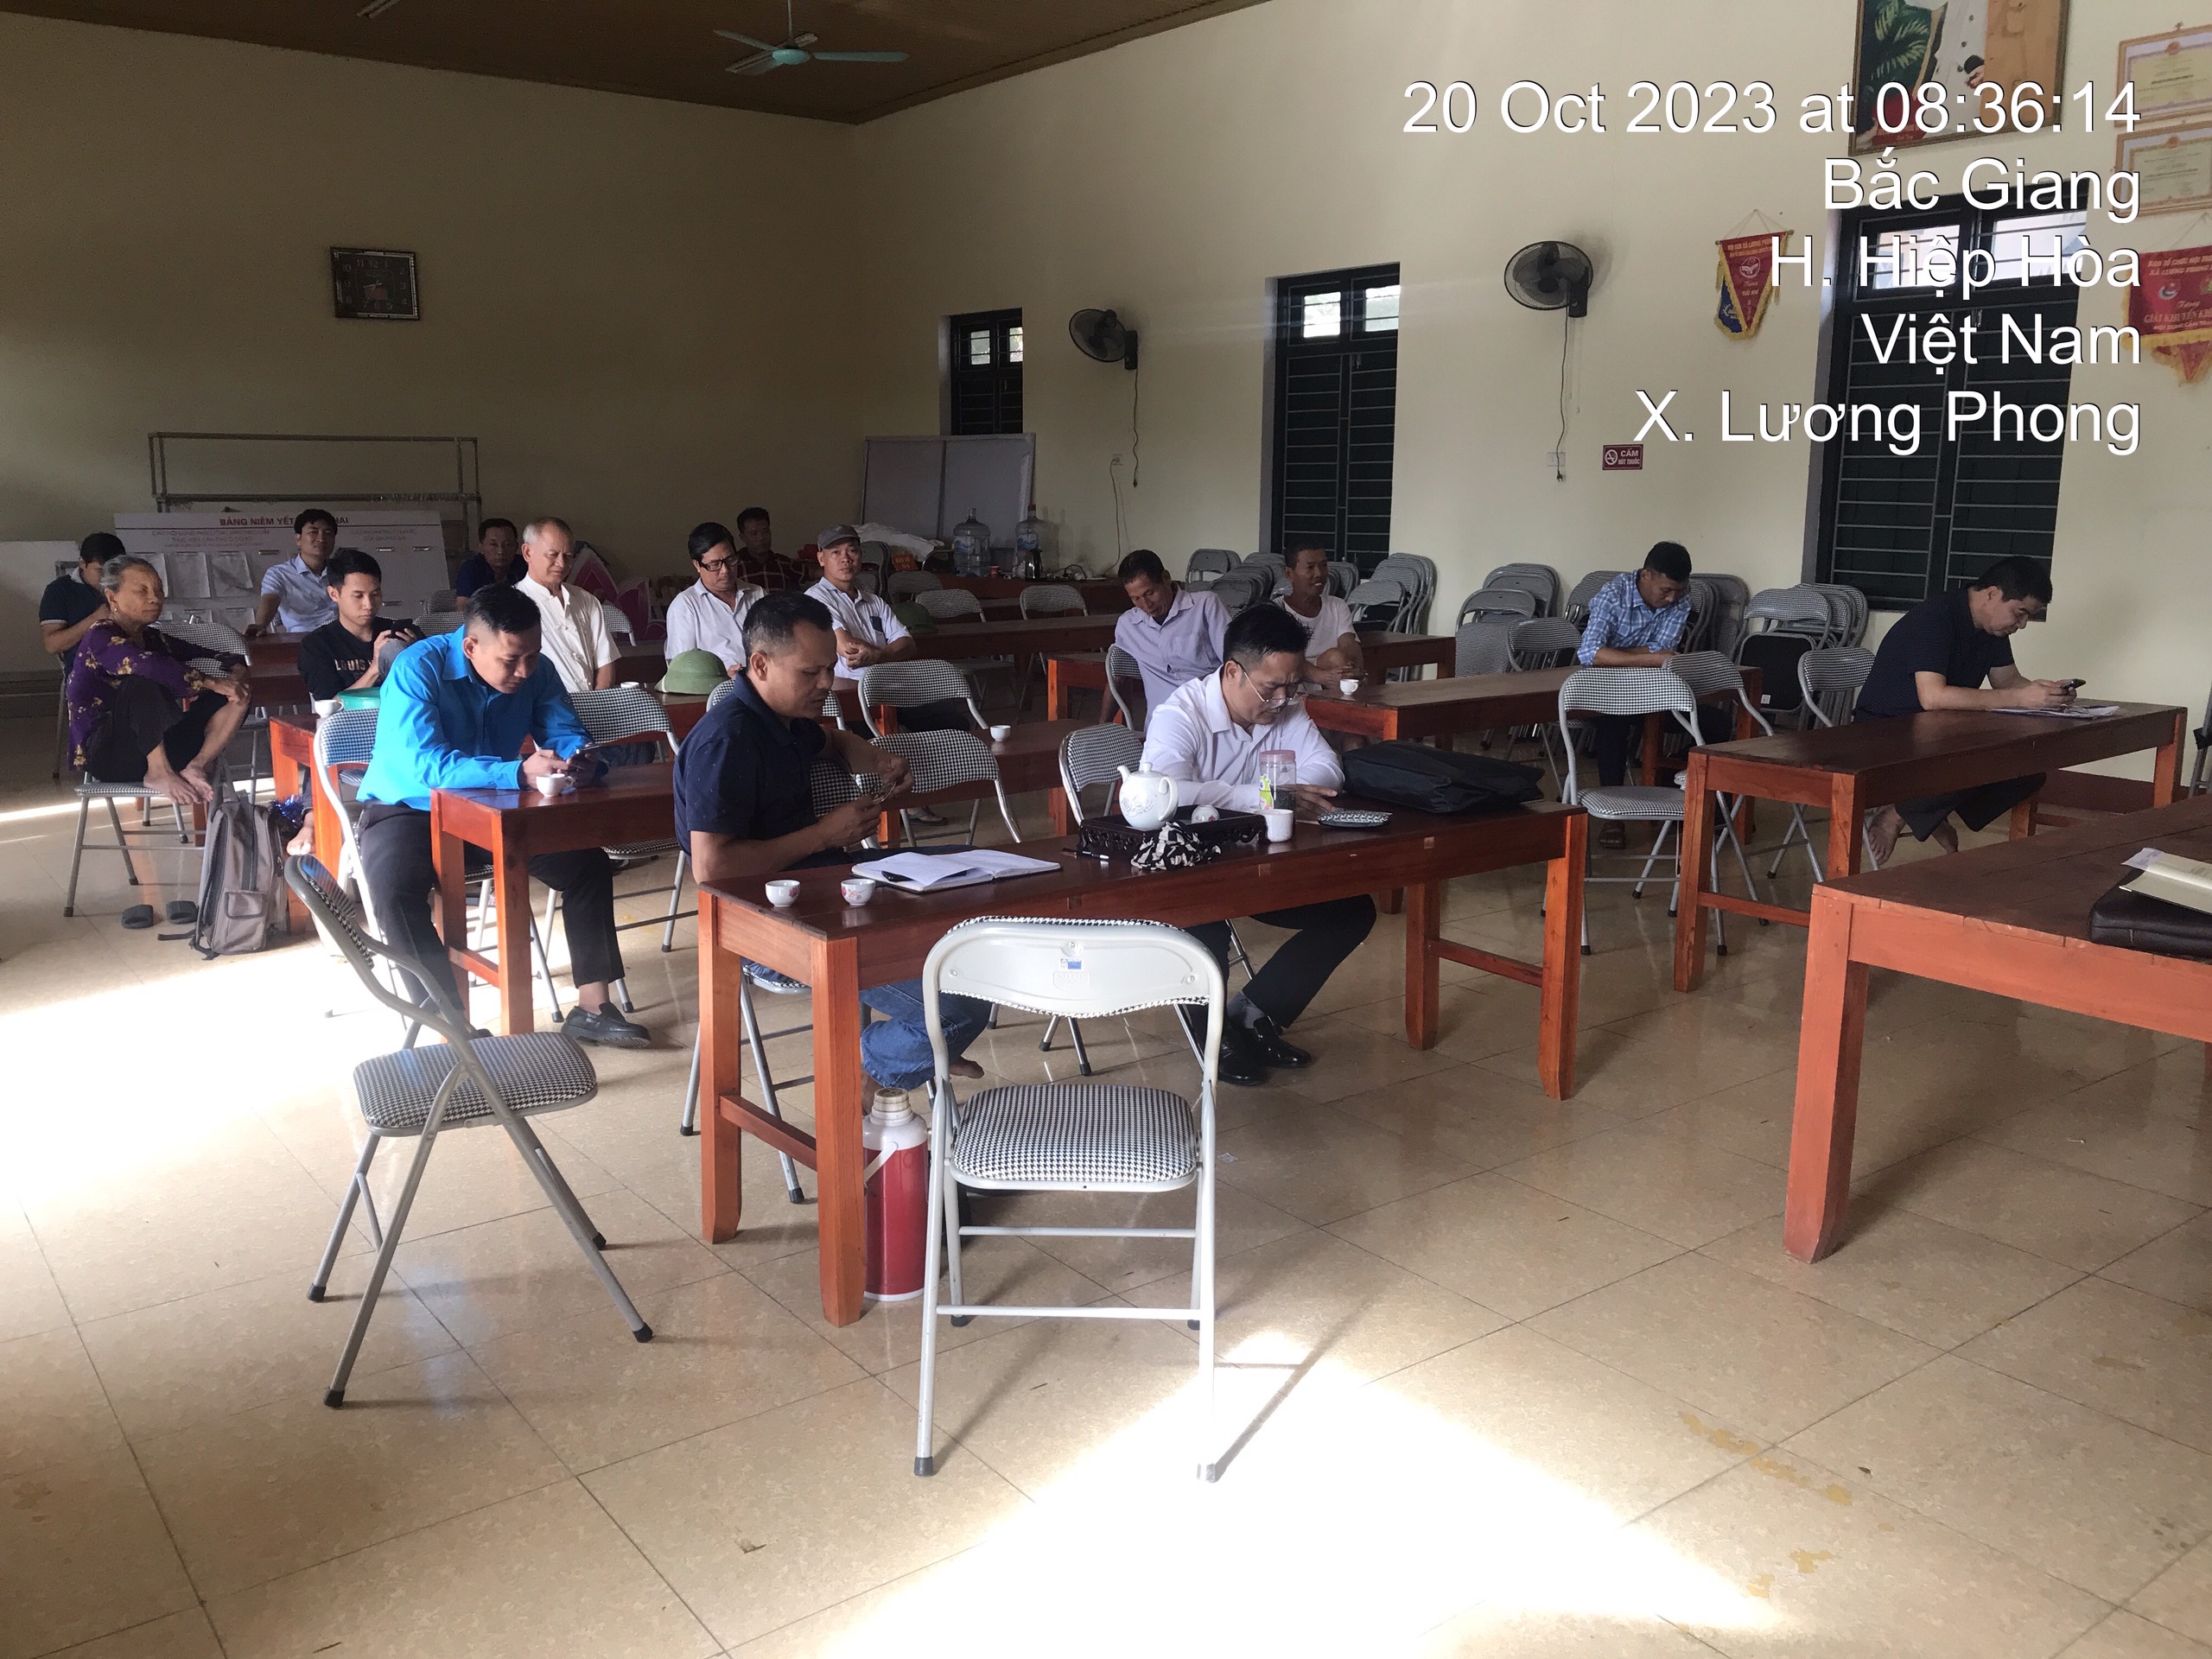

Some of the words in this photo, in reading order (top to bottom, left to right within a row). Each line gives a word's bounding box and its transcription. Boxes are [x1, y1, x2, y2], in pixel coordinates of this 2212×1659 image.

[1621, 448, 1638, 457] CẤM
[219, 517, 248, 525] BẢNG
[250, 517, 274, 525] NIÊM
[276, 515, 294, 525] YẾT
[334, 658, 365, 671] LOUIS
